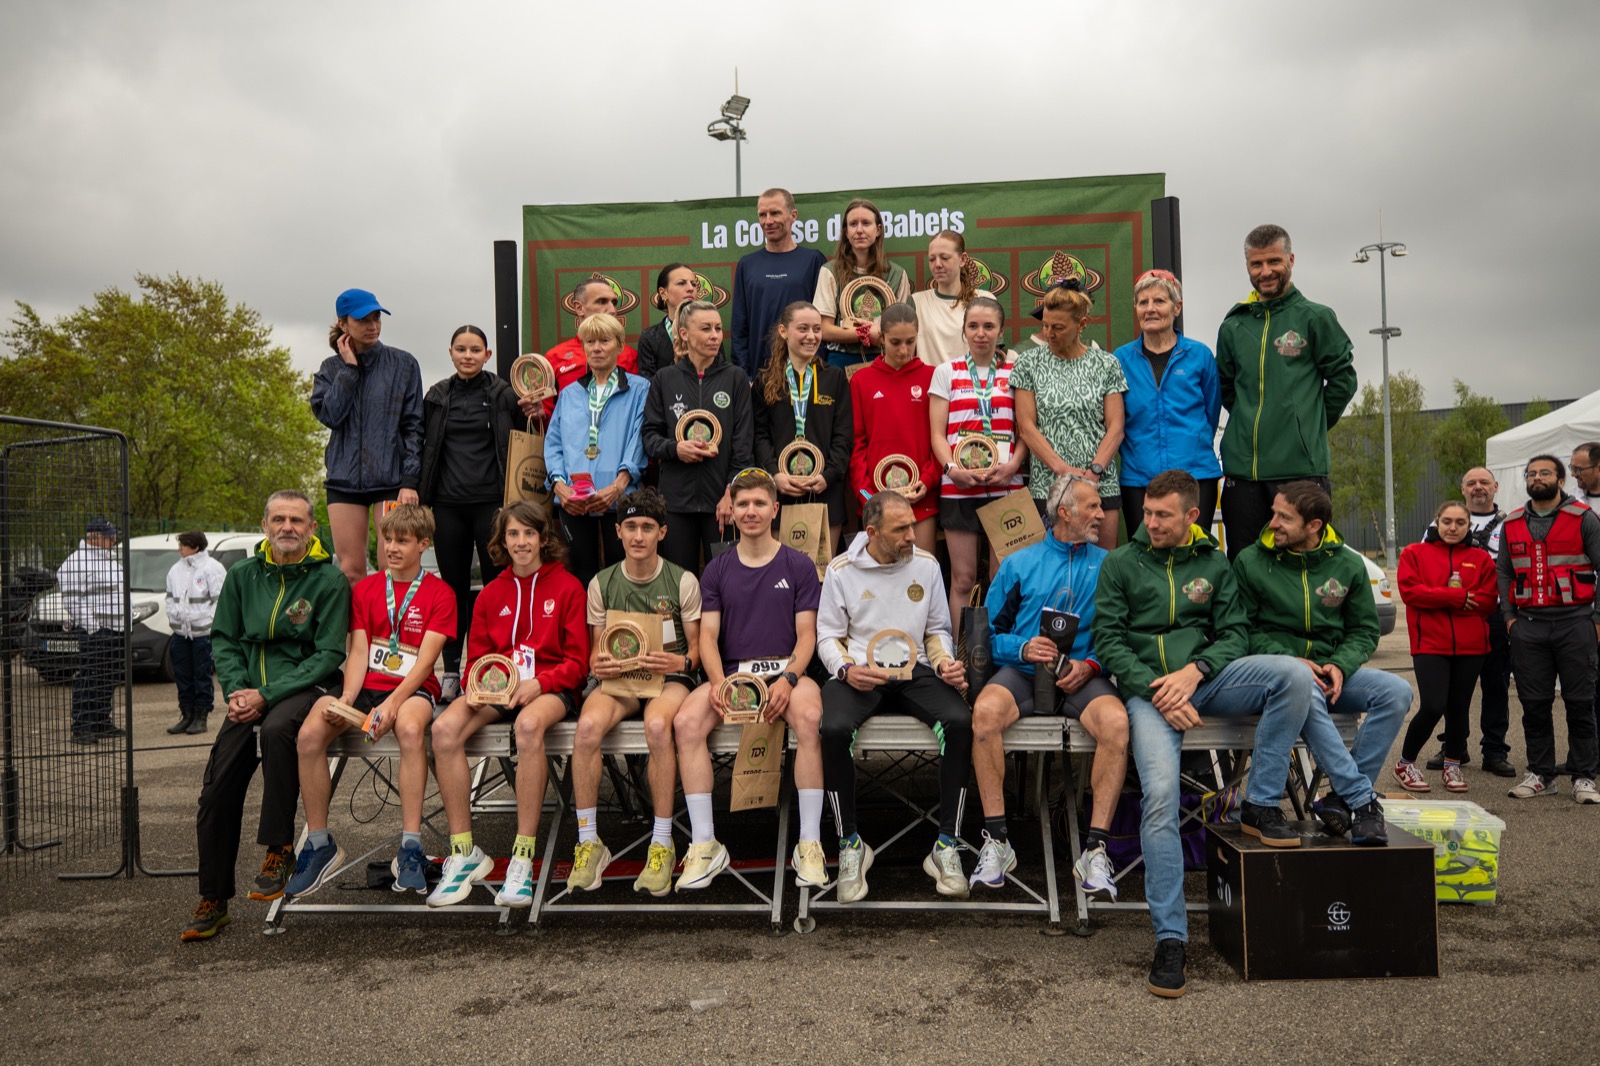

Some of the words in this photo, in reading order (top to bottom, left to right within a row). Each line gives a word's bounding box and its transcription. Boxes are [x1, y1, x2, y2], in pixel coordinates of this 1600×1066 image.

[702, 222, 728, 249] La
[735, 219, 819, 247] Cose
[1003, 515, 1023, 531] TDR
[792, 530, 806, 540] TDR
[1535, 544, 1545, 605] SECOURISTE
[751, 747, 766, 758] TDR
